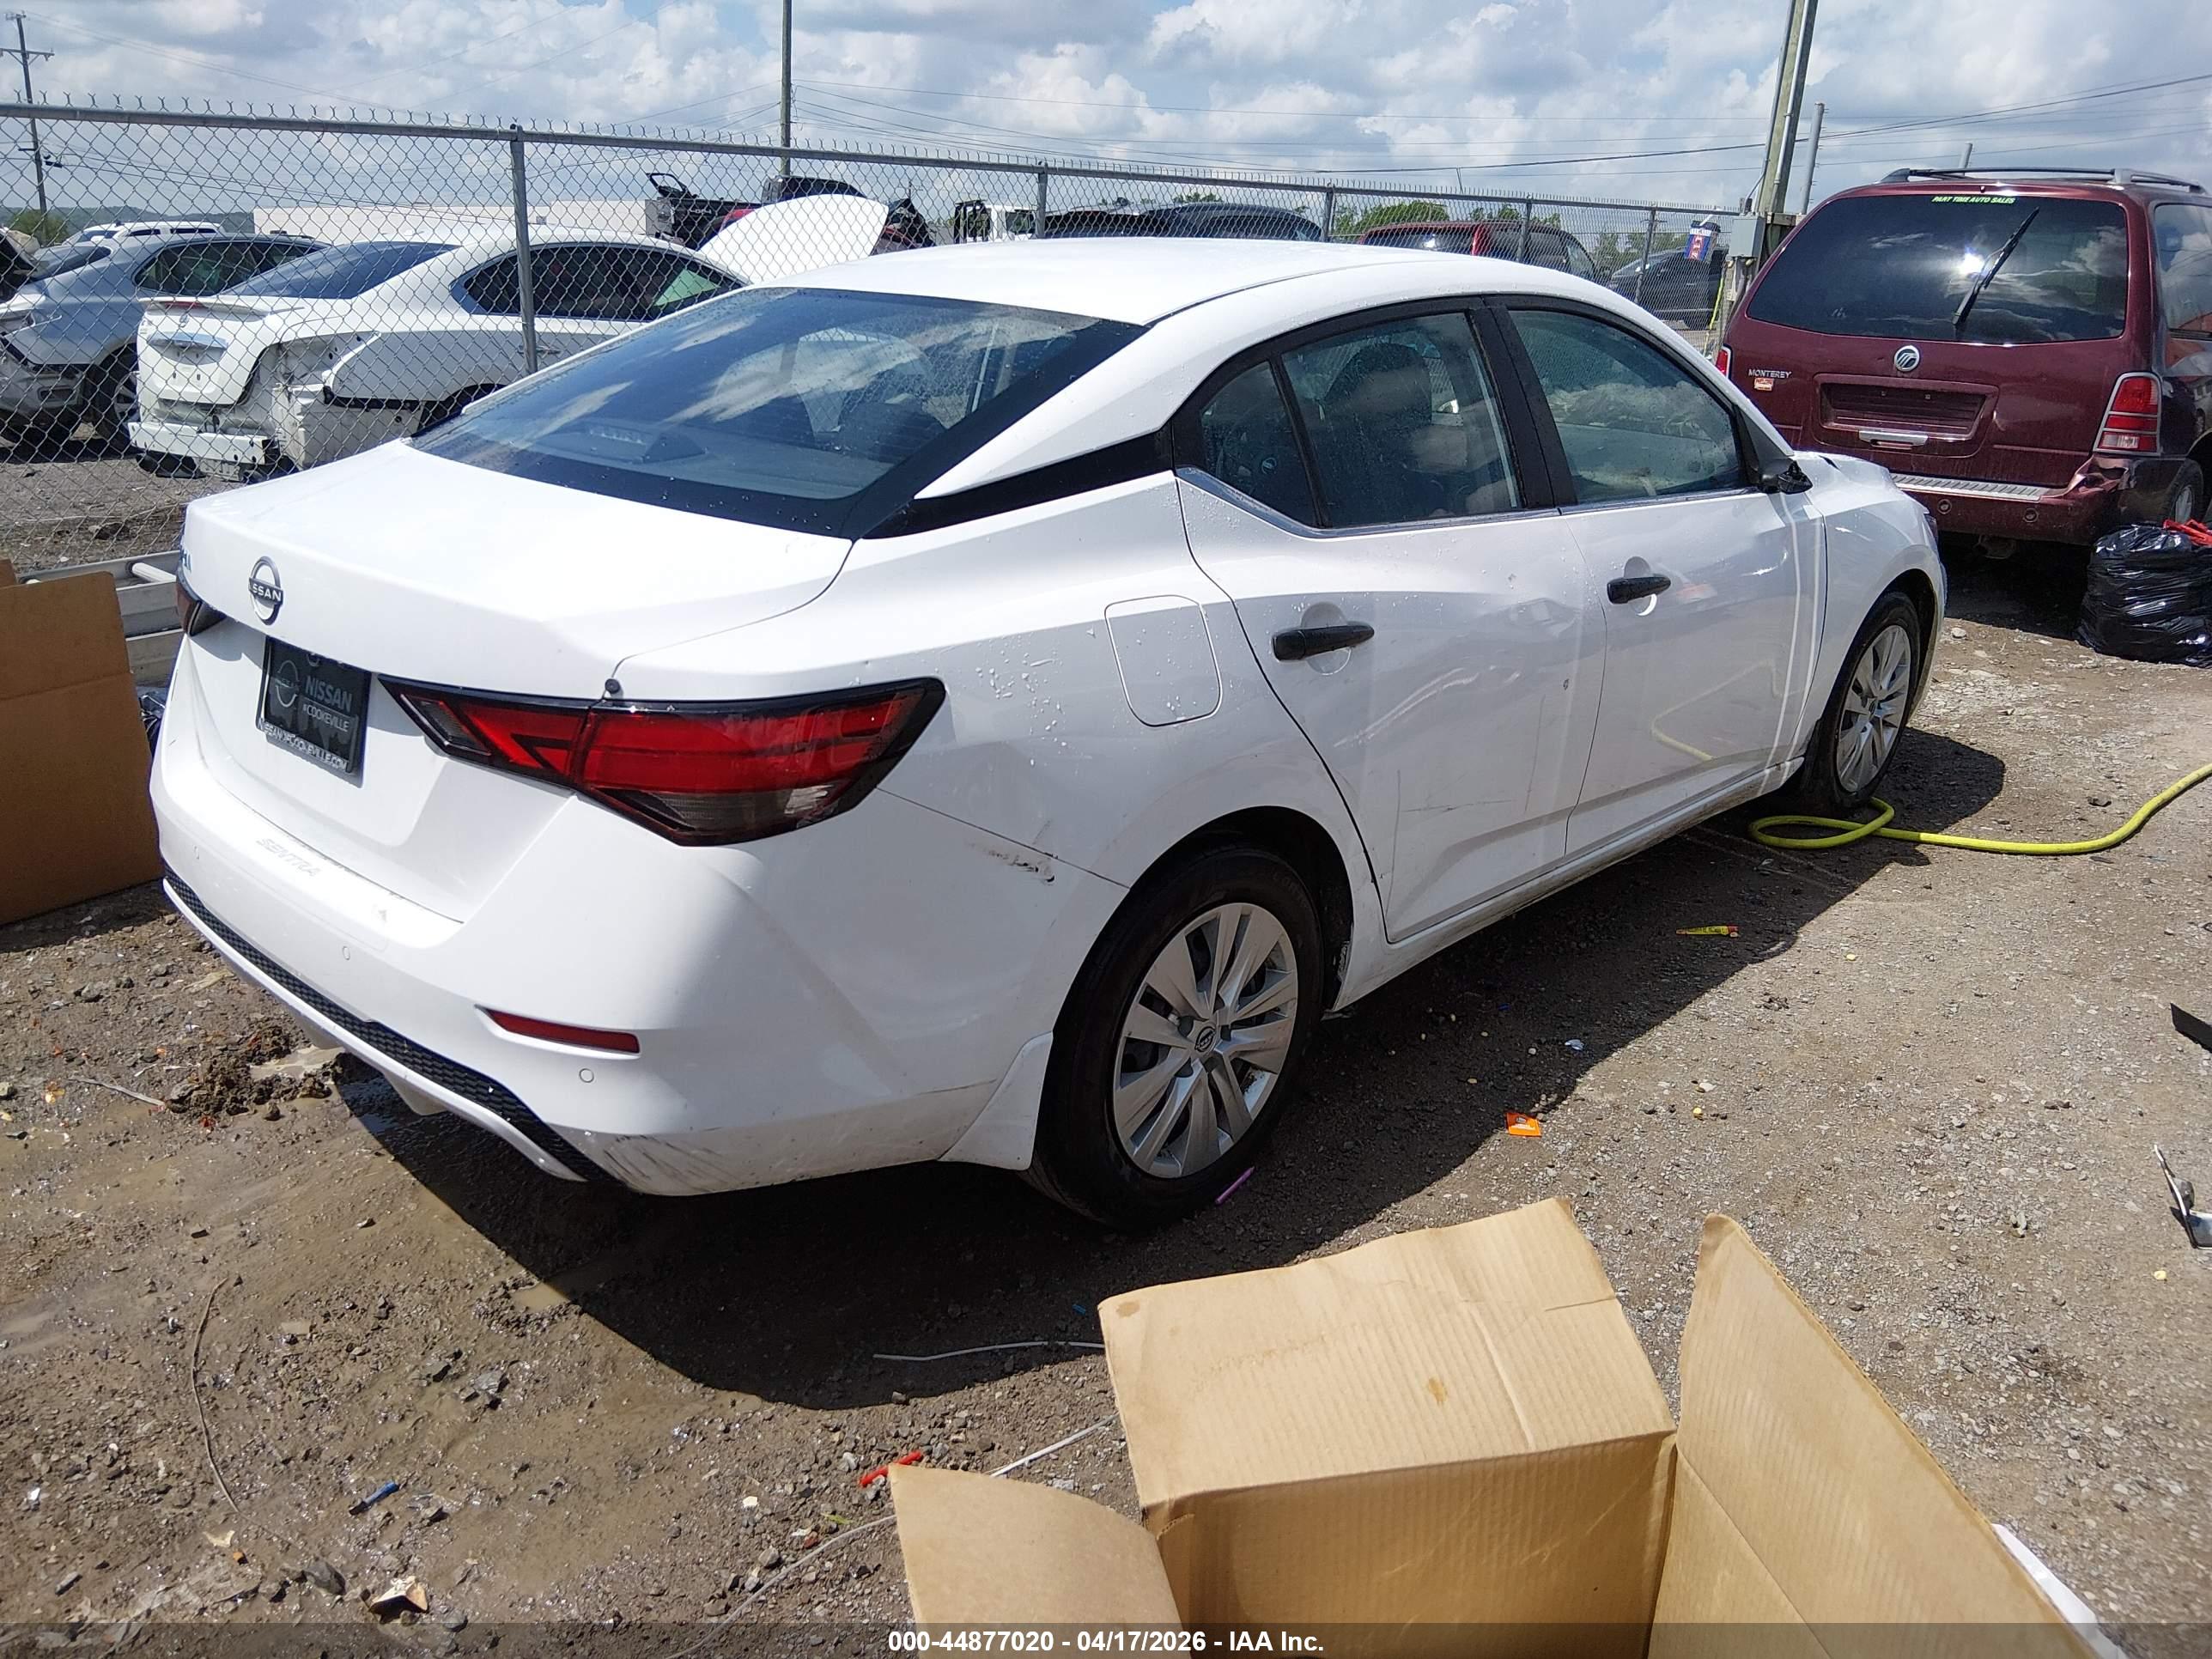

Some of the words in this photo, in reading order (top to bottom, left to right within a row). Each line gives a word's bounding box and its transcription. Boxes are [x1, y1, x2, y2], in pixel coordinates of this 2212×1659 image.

[1748, 368, 1792, 379] MONTEREY
[251, 581, 282, 602] SSAN
[306, 675, 352, 713] NISSAN
[255, 838, 322, 878] SENTRA
